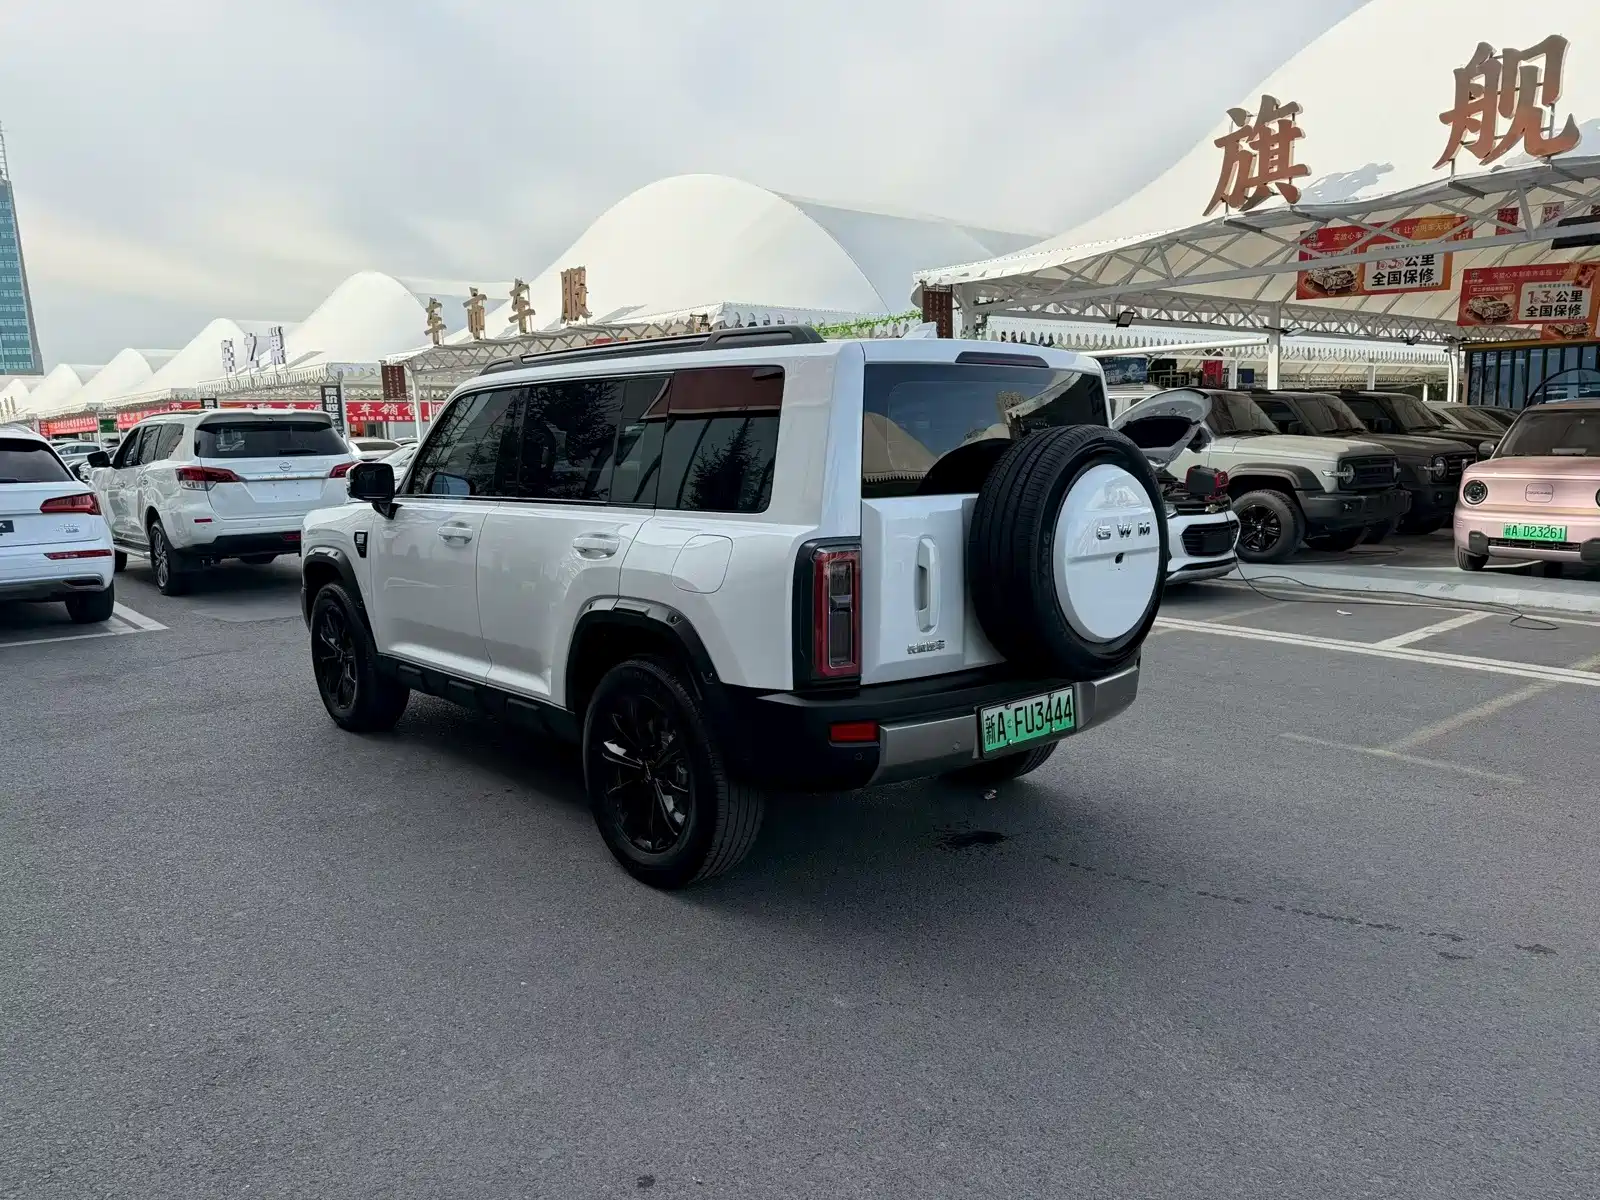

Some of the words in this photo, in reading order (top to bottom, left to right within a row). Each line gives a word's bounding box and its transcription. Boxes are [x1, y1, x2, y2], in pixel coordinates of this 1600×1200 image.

[1371, 268, 1435, 287] 全国保修
[1525, 303, 1582, 318] 全国保修
[1096, 520, 1151, 540] GWM
